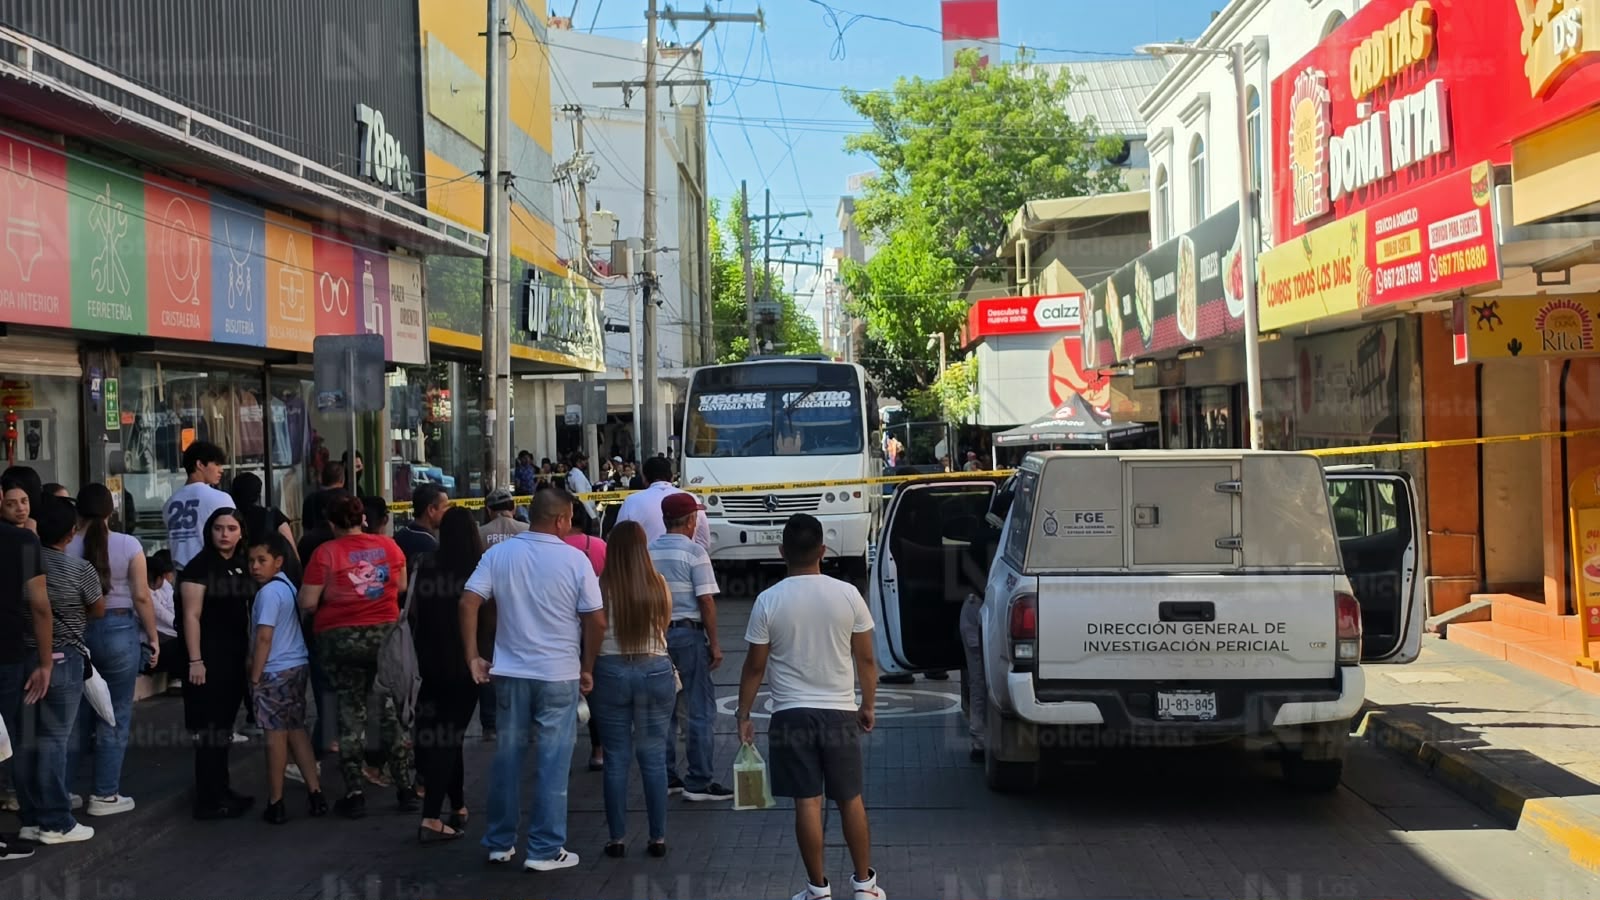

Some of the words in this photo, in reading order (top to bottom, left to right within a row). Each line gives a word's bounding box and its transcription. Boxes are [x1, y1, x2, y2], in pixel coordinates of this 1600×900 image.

[1350, 1, 1432, 99] ORDITAS
[1330, 104, 1391, 202] DOÑA
[1389, 80, 1450, 171] RITA
[1438, 255, 1452, 277] 667
[1452, 250, 1465, 274] 716
[1465, 244, 1487, 271] 0880
[1266, 277, 1292, 308] COMBOS
[1293, 267, 1316, 297] TODOS
[1316, 263, 1332, 291] LOS
[1333, 249, 1351, 285] DÍAS
[17, 291, 60, 314] INTERIOR
[87, 299, 133, 322] FERRETERÍA
[987, 307, 1020, 317] Descubre
[1020, 306, 1028, 315] la
[161, 310, 201, 329] CRISTALERÍA
[225, 315, 255, 336] BISUTERÍA
[987, 316, 1009, 324] nueva
[1009, 315, 1027, 323] zona
[1542, 329, 1583, 351] Rita
[699, 392, 767, 405] VEGAS
[752, 481, 785, 491] PRECAUCIÓN
[168, 499, 200, 530] 25
[1074, 512, 1104, 523] FGE
[1087, 621, 1176, 635] DIRECCIÓN
[1182, 622, 1259, 635] GENERAL
[1264, 622, 1286, 634] DE
[1084, 638, 1209, 652] INVESTIGACIÓN
[1216, 639, 1290, 652] PERICIAL
